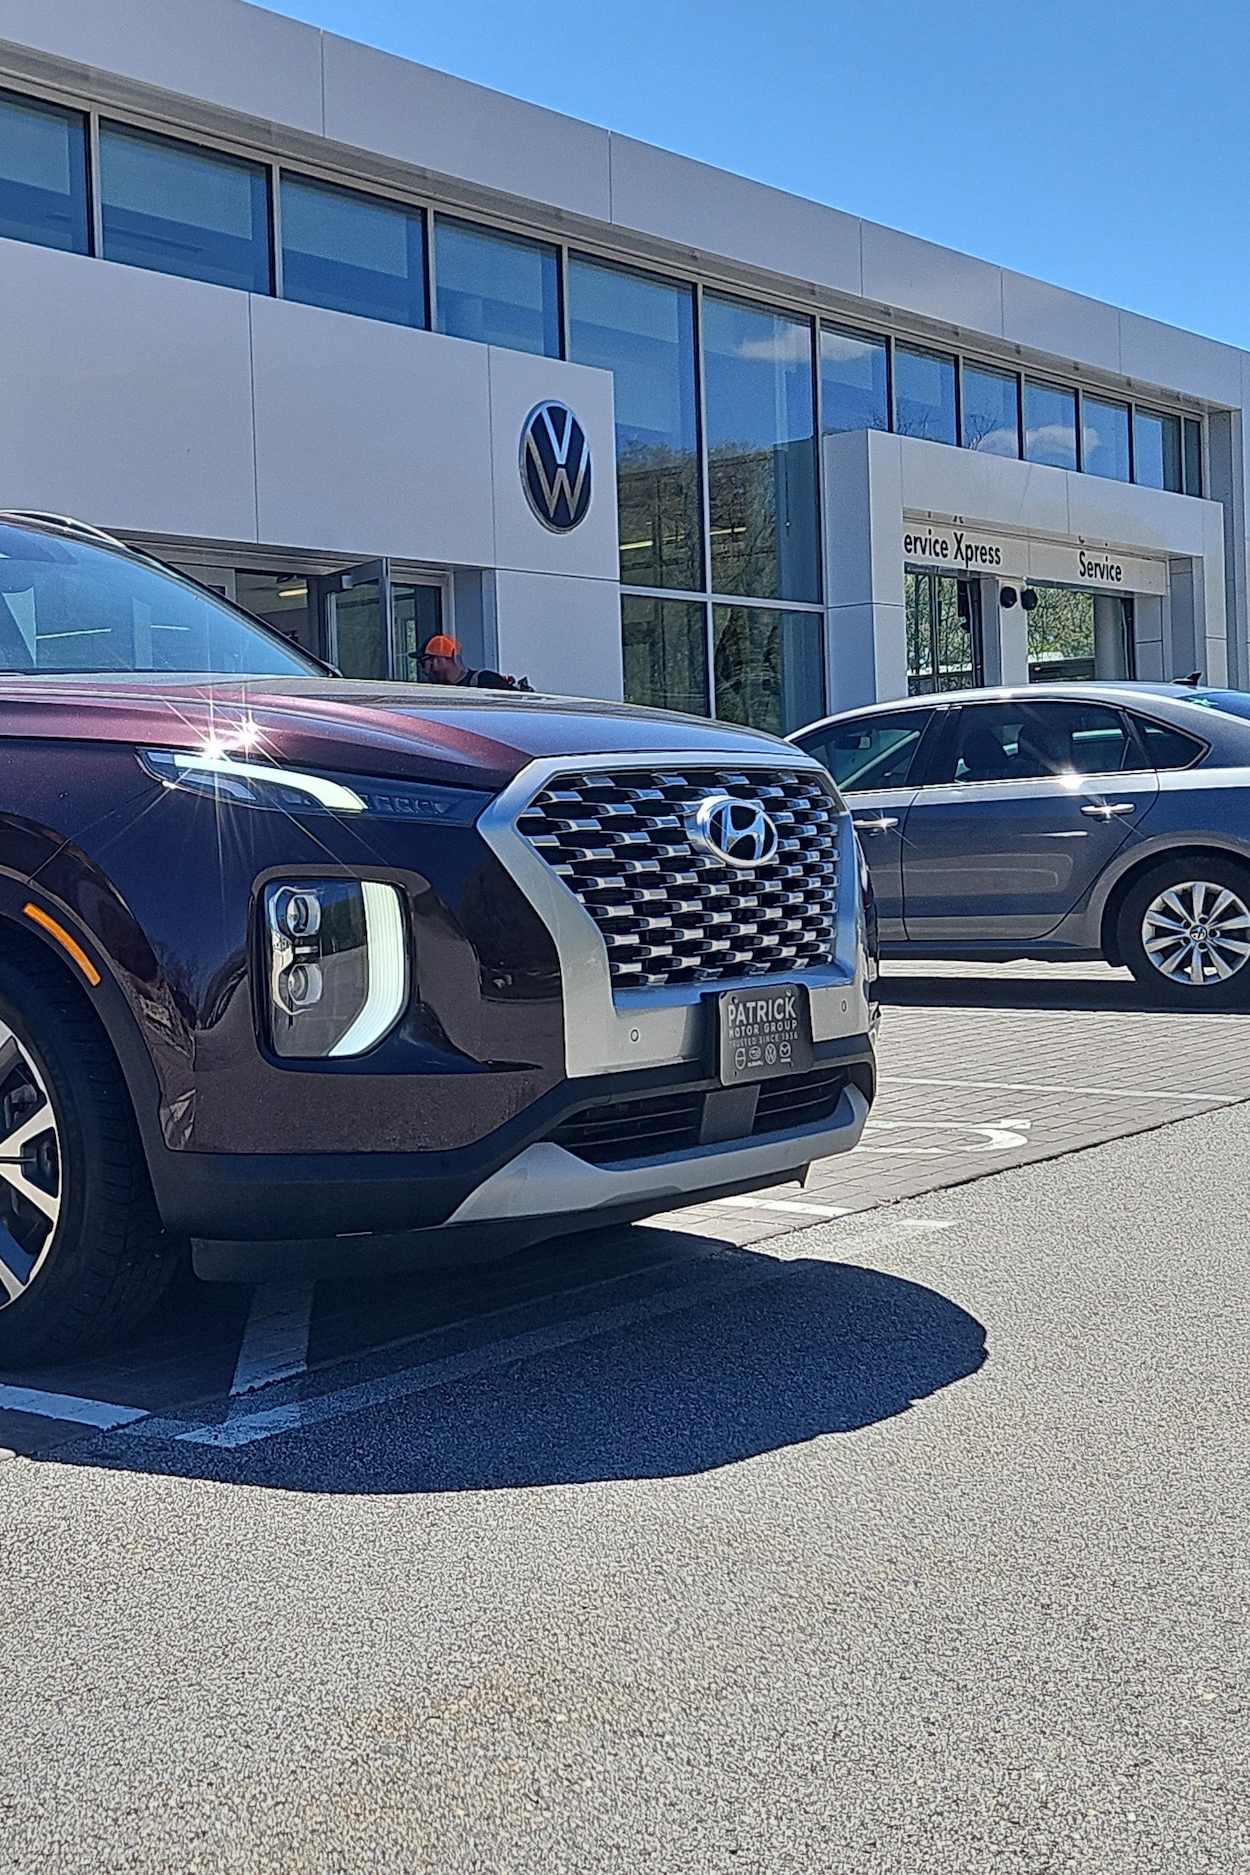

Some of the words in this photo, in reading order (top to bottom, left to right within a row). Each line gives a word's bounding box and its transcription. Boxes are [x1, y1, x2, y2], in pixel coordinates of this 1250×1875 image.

[904, 528, 949, 559] ervice
[953, 531, 1001, 569] Xpress
[1079, 550, 1122, 582] Service
[728, 998, 797, 1027] PATRICK
[729, 1025, 759, 1039] MOTOR
[764, 1020, 797, 1033] GROUP
[759, 1034, 779, 1044] SINCE
